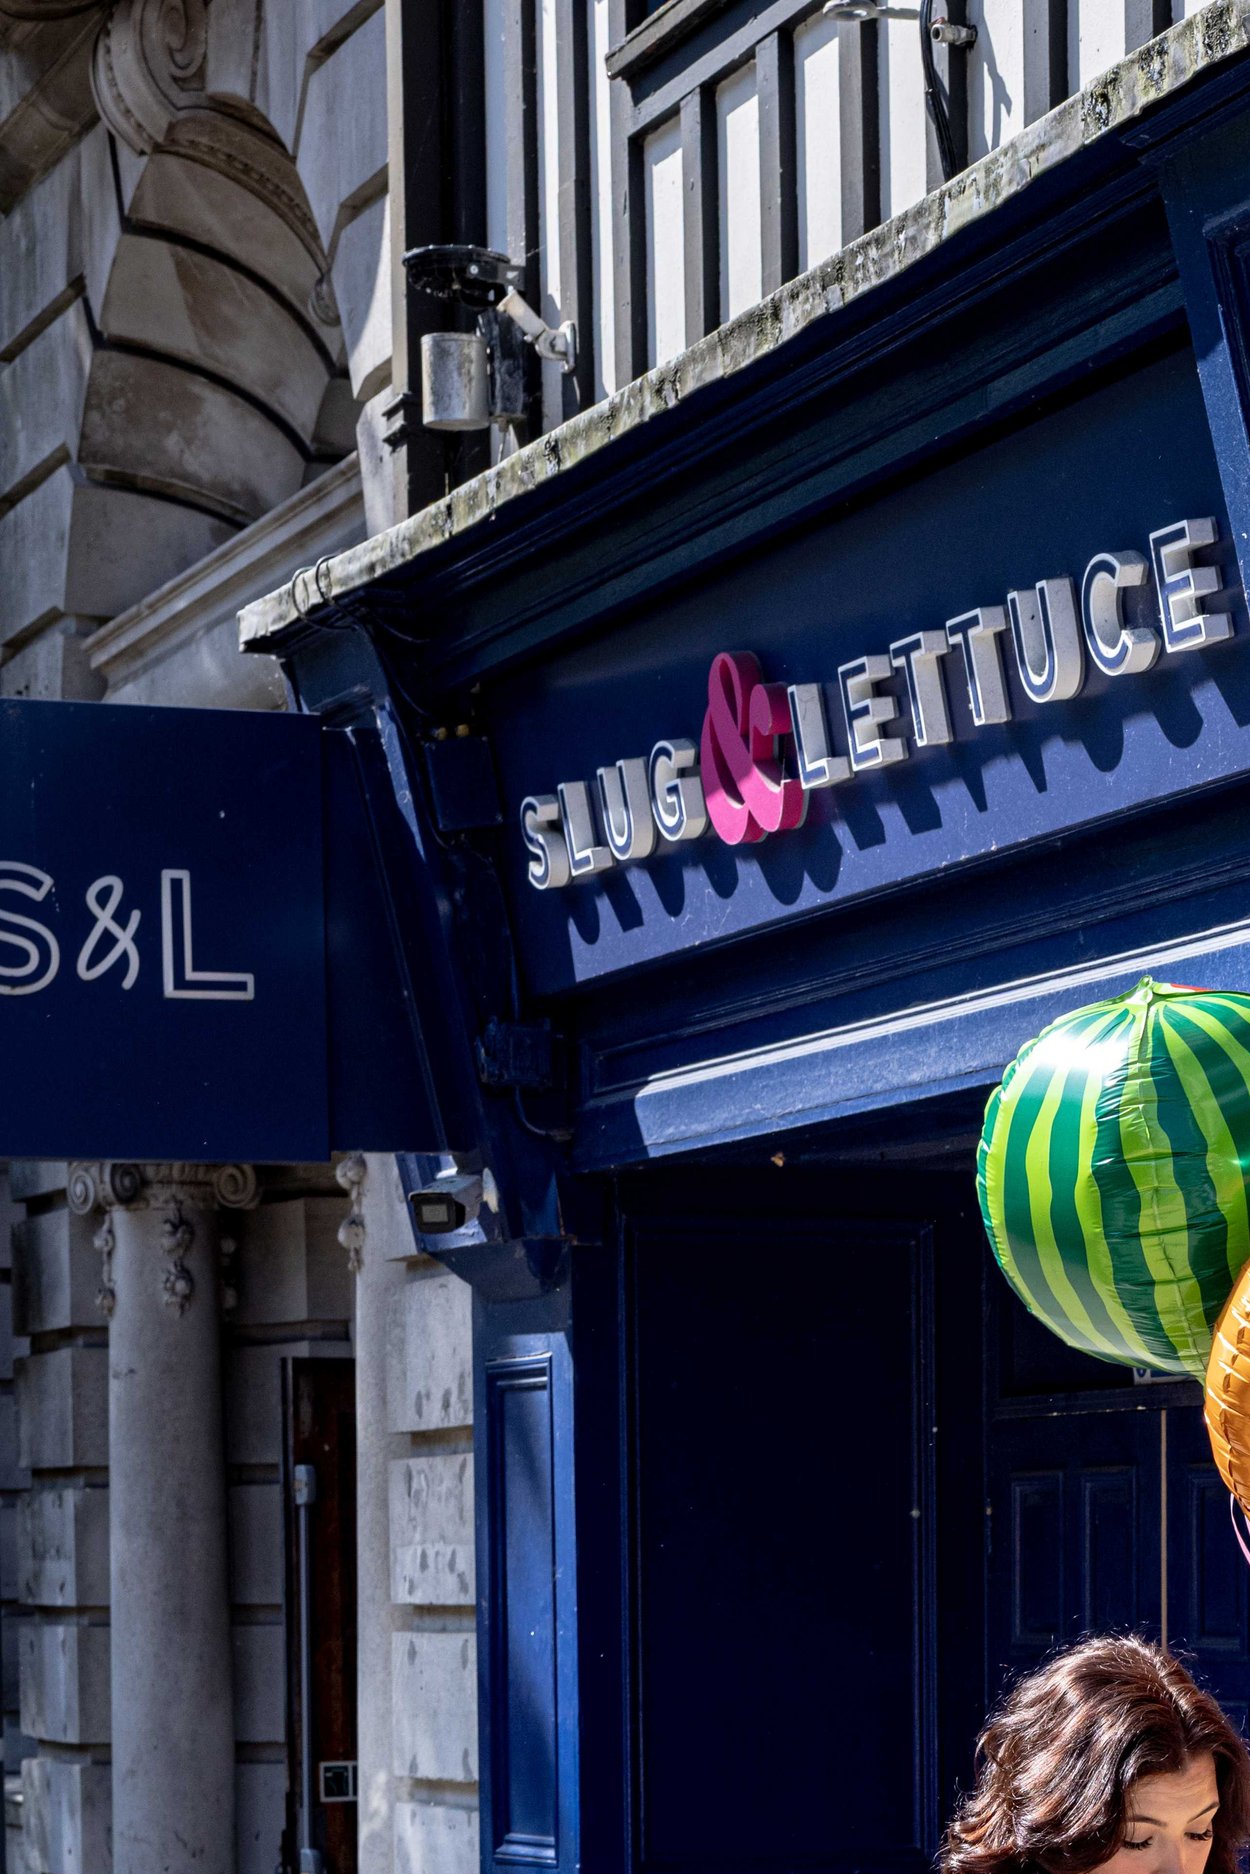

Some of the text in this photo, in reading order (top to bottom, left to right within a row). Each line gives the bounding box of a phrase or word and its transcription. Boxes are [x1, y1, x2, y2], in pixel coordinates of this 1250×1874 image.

[520, 516, 1234, 889] SLUG & LETTUCE
